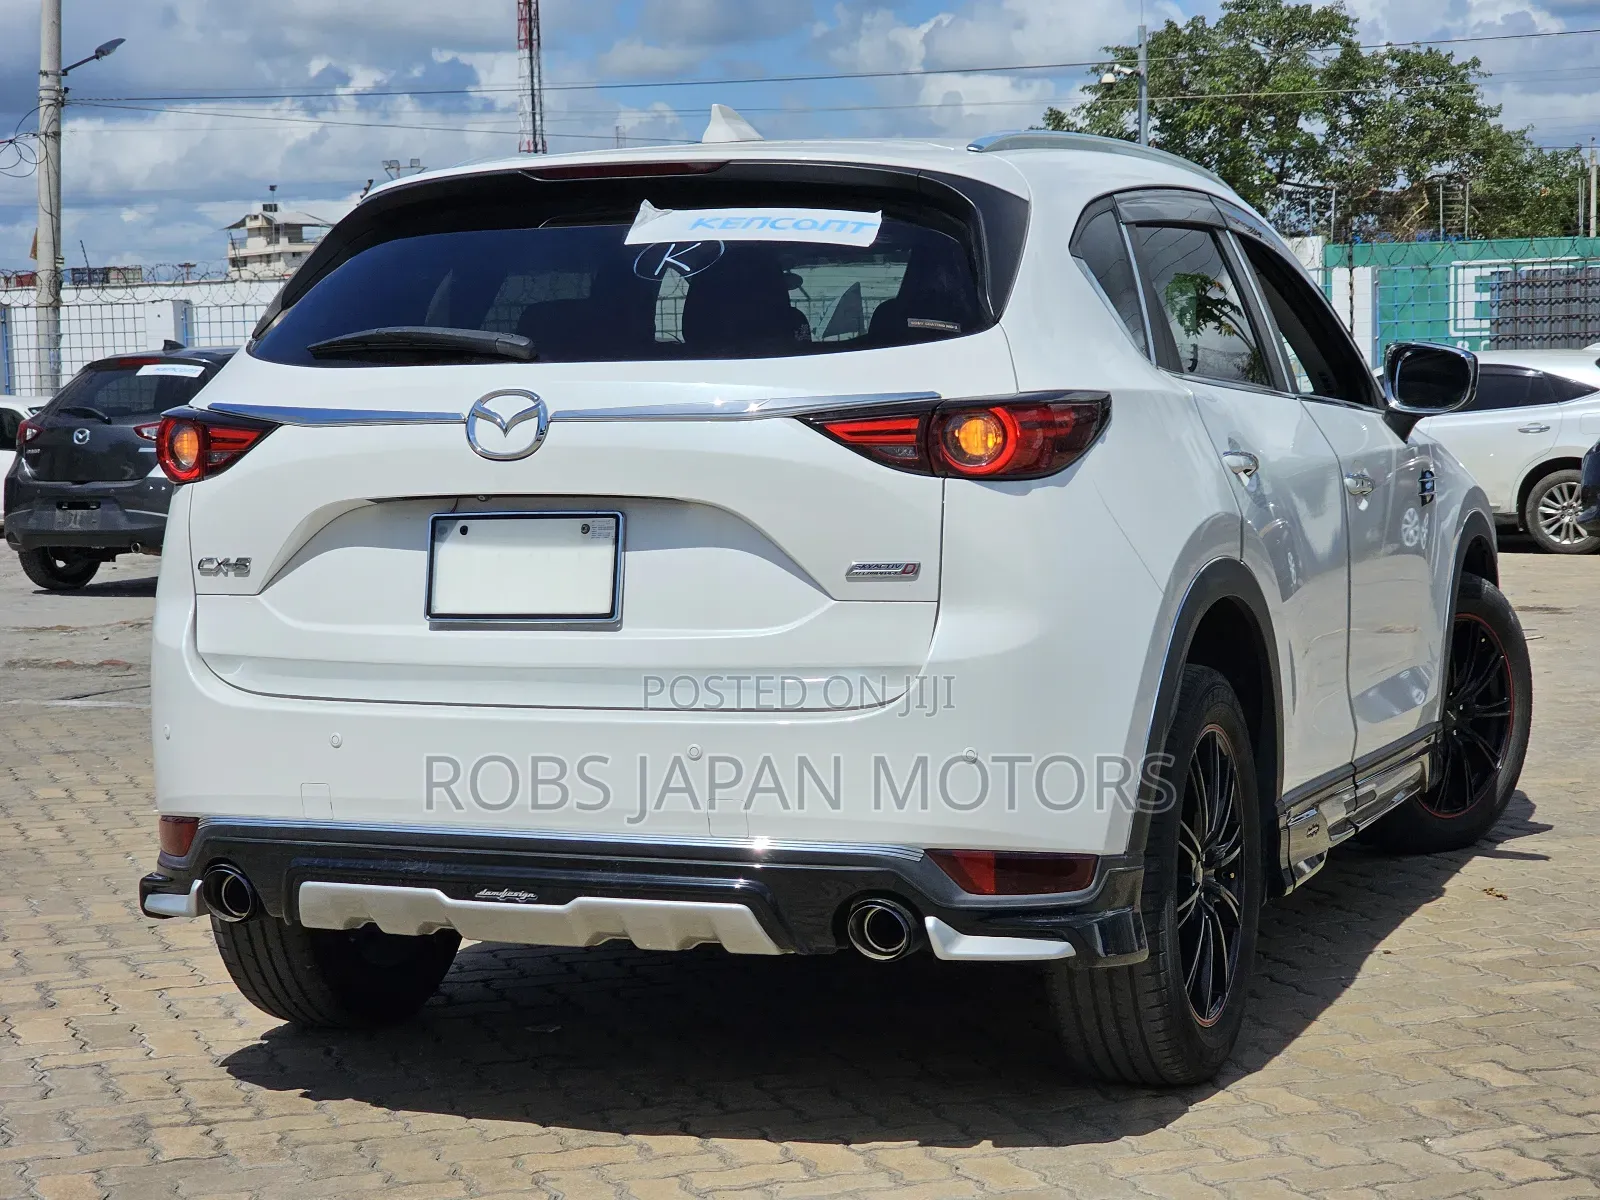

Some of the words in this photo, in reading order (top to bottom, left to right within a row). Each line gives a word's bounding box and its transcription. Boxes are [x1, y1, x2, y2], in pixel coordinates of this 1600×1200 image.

[654, 242, 702, 276] K
[197, 557, 252, 577] CX-5
[853, 563, 905, 571] SKYACTIV
